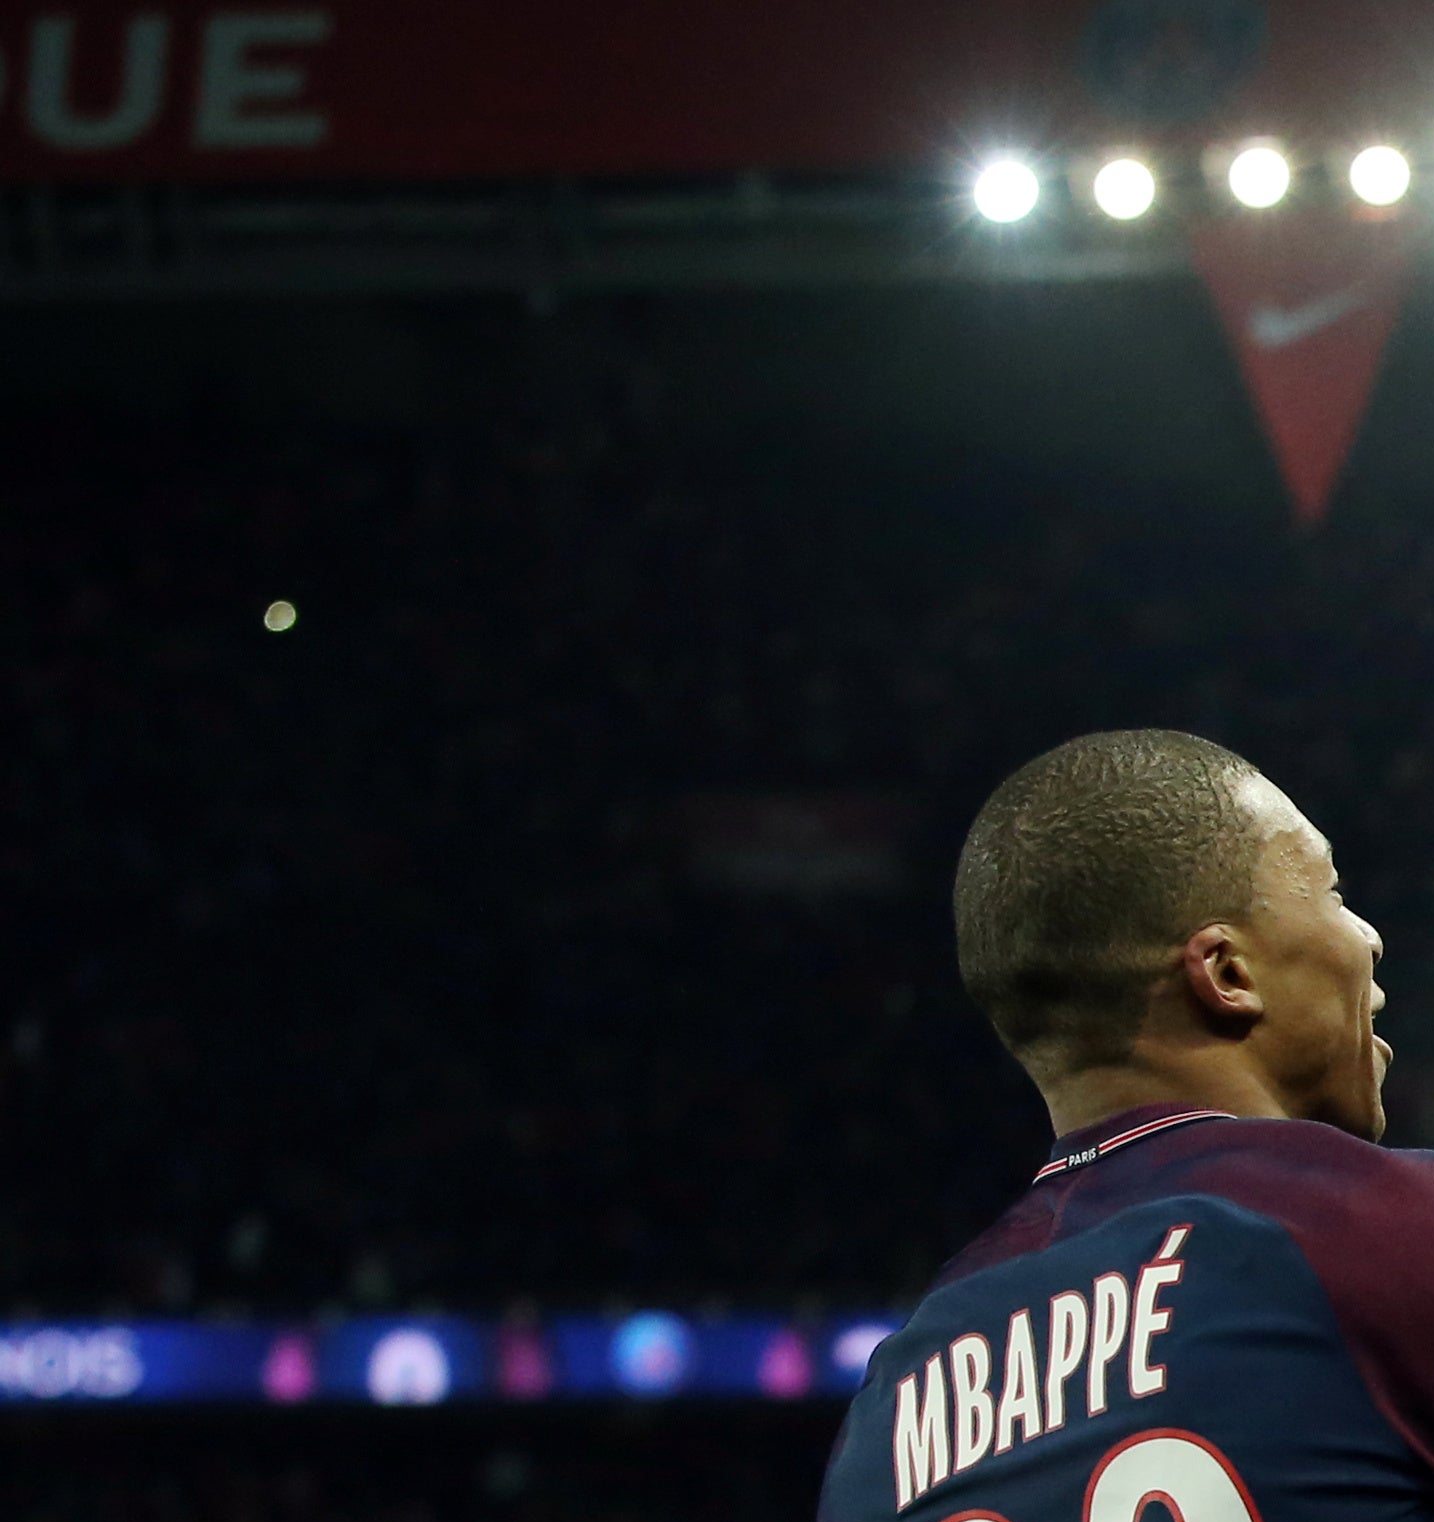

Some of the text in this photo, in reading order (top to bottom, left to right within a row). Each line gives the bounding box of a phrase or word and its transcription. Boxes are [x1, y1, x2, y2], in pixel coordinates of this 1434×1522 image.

[0, 9, 335, 153] UE
[1068, 1147, 1097, 1167] PARIS
[892, 1223, 1194, 1514] MBAPPÉ
